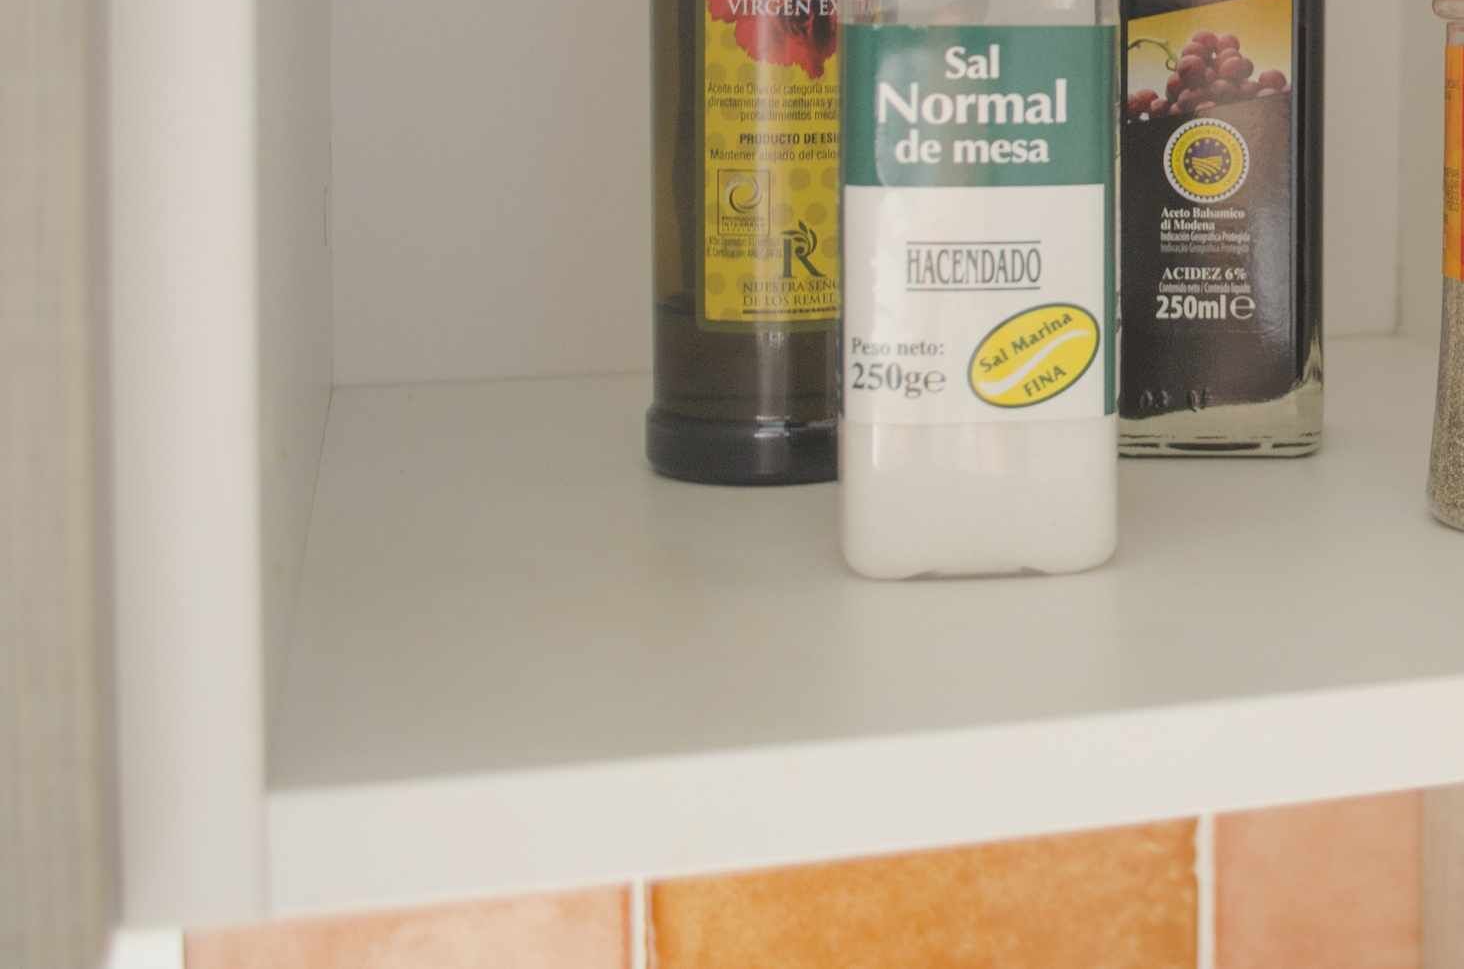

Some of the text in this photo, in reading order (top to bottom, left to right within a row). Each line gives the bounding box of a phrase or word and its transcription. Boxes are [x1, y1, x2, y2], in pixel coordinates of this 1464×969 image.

[944, 44, 1001, 80] Sal
[877, 78, 1067, 126] Normal
[740, 133, 801, 145] PRODUCTO
[804, 133, 817, 144] DE
[895, 128, 1051, 164] de mesa
[710, 149, 754, 160] Mantener
[798, 149, 814, 159] del
[1160, 206, 1246, 219] Aceto Balsamico
[1160, 219, 1216, 231] di Modena
[906, 248, 1042, 285] HACENDADO
[1162, 267, 1248, 281] ACIDEZ 6%
[1155, 295, 1227, 320] 250ml
[851, 337, 945, 356] Peso neto:
[979, 312, 1073, 373] Sal Marina
[1023, 365, 1067, 398] FINA
